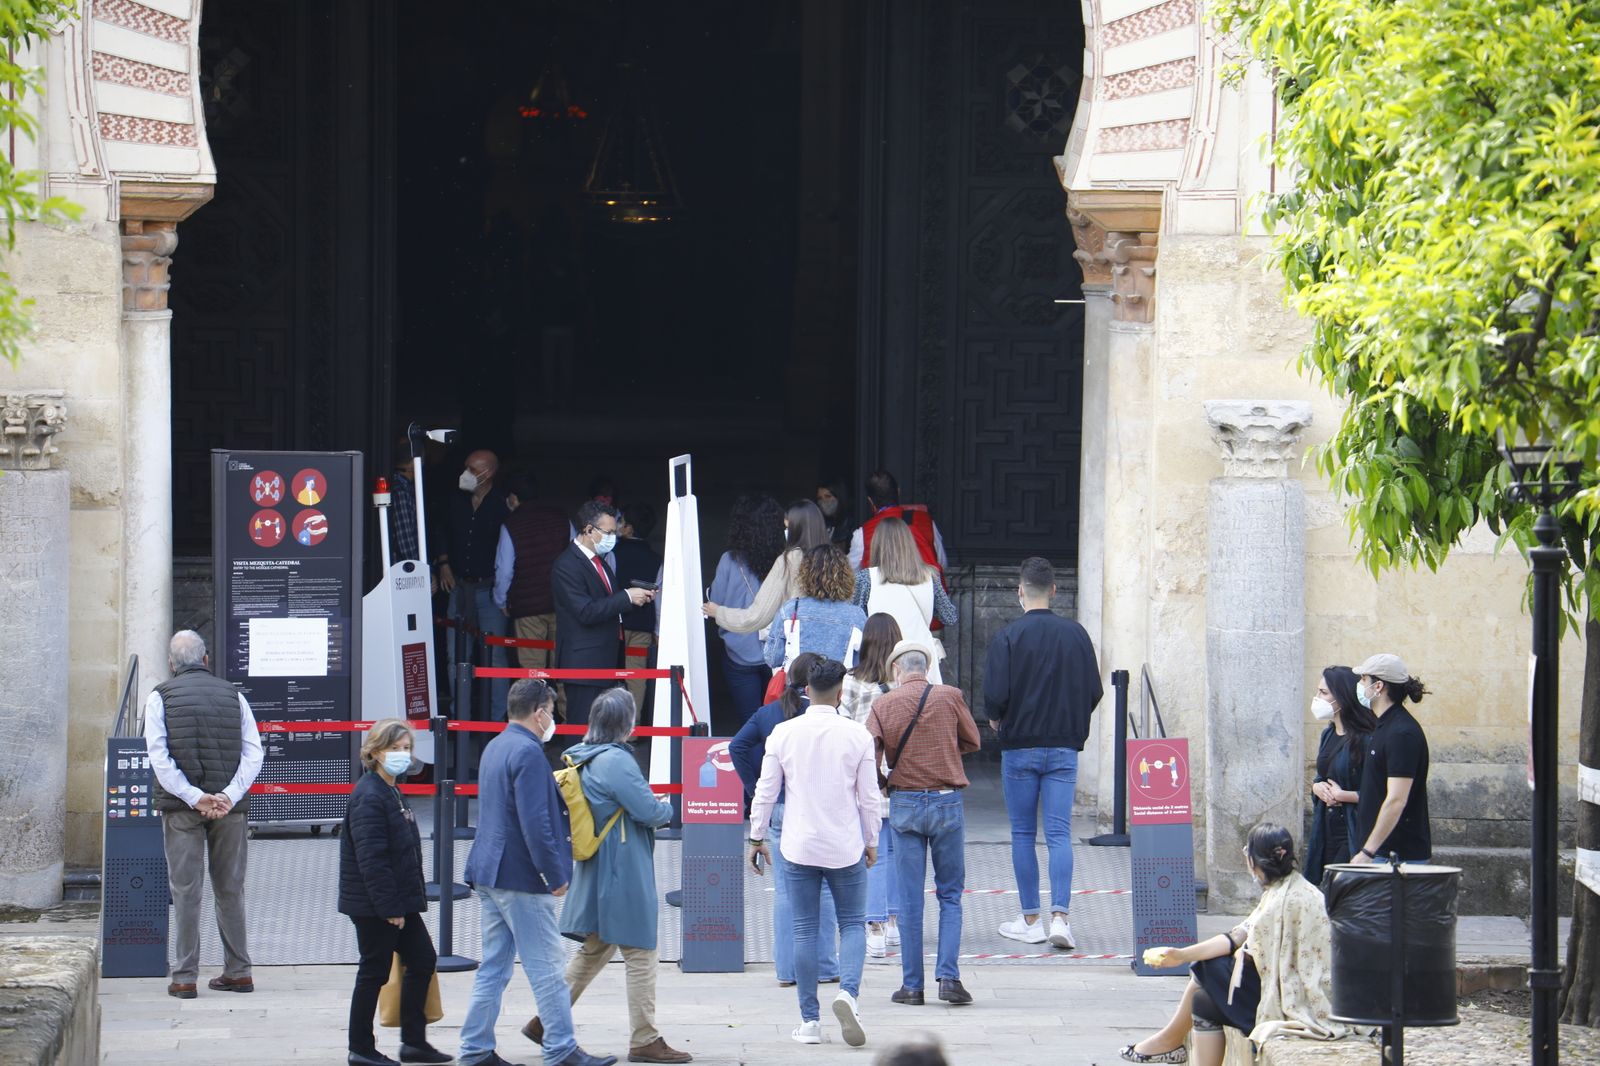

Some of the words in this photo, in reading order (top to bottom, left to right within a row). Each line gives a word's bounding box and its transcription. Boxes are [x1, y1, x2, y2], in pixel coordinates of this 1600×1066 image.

[690, 923, 737, 932] CATEDRAL
[1143, 927, 1189, 935] CATEDRAL
[111, 928, 160, 936] CATEDRAL
[684, 933, 696, 941] DE
[1137, 936, 1149, 944] DE
[1151, 934, 1197, 944] CÓRDOBA
